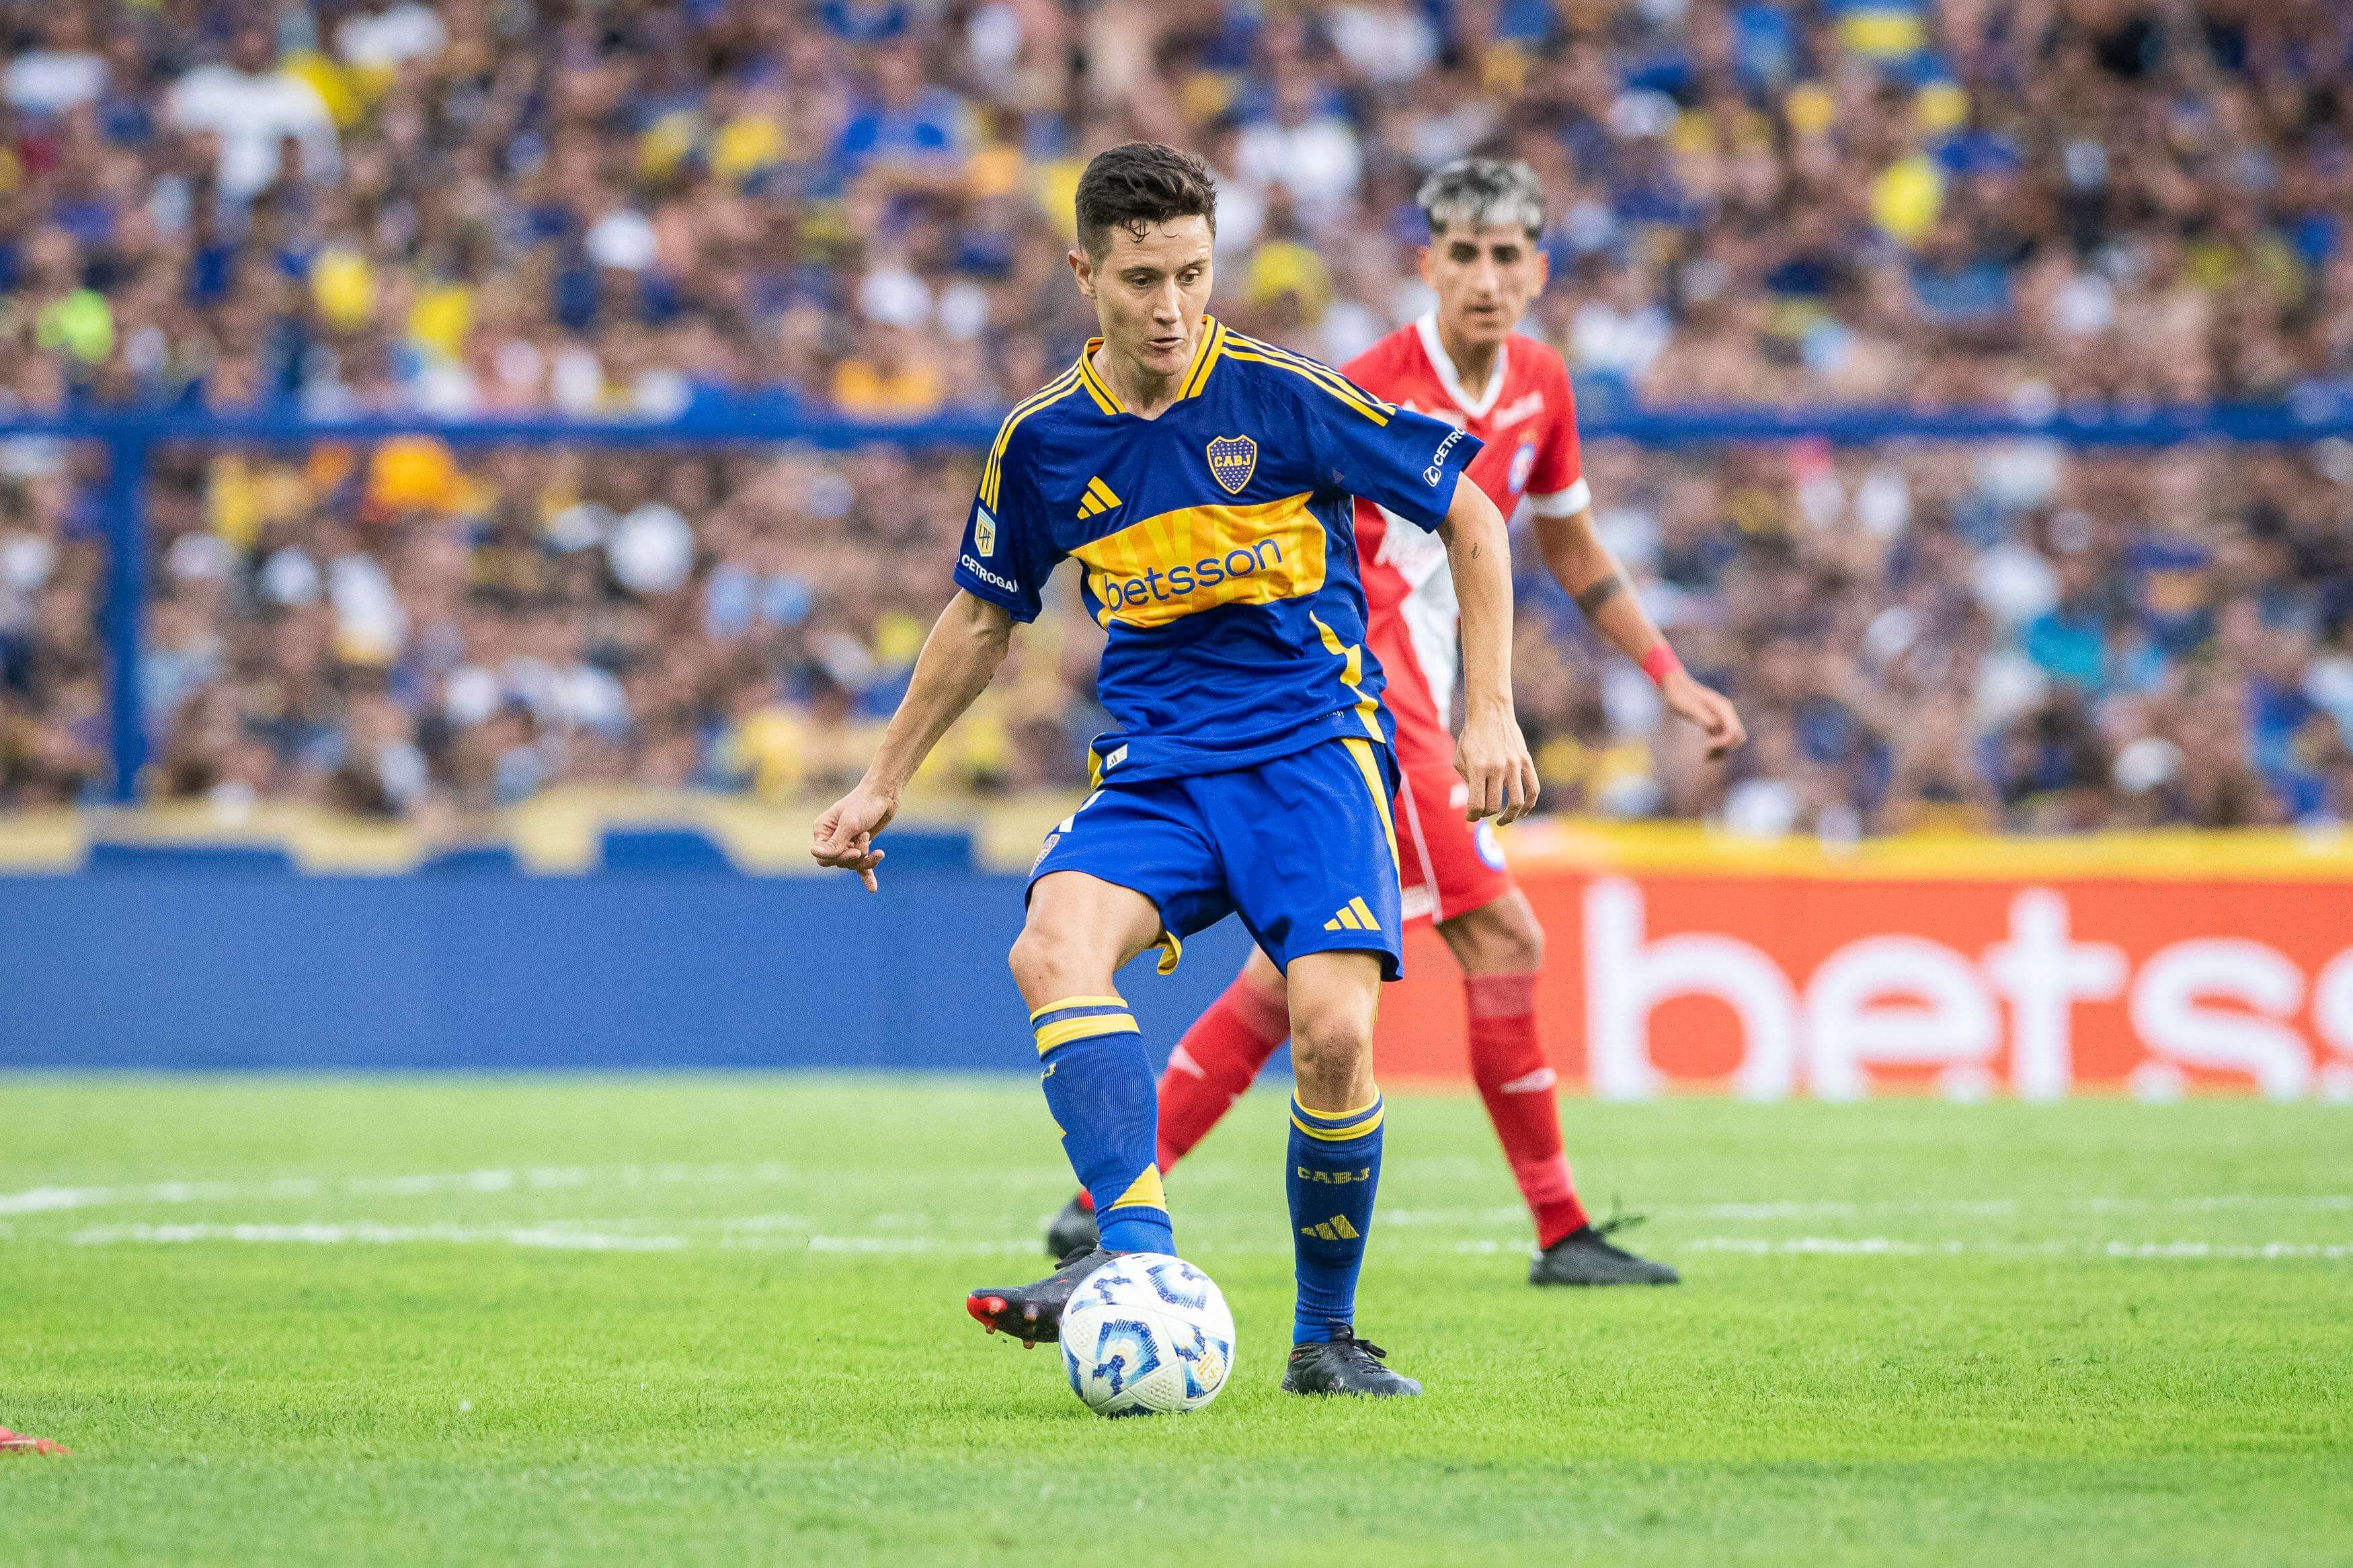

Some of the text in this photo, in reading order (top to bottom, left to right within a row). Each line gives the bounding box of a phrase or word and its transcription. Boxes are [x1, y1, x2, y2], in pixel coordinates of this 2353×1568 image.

[1214, 454, 1250, 467] CABJ
[1104, 538, 1283, 612] betsson
[1583, 876, 2353, 1101] bets
[1298, 1166, 1370, 1184] CABJ
